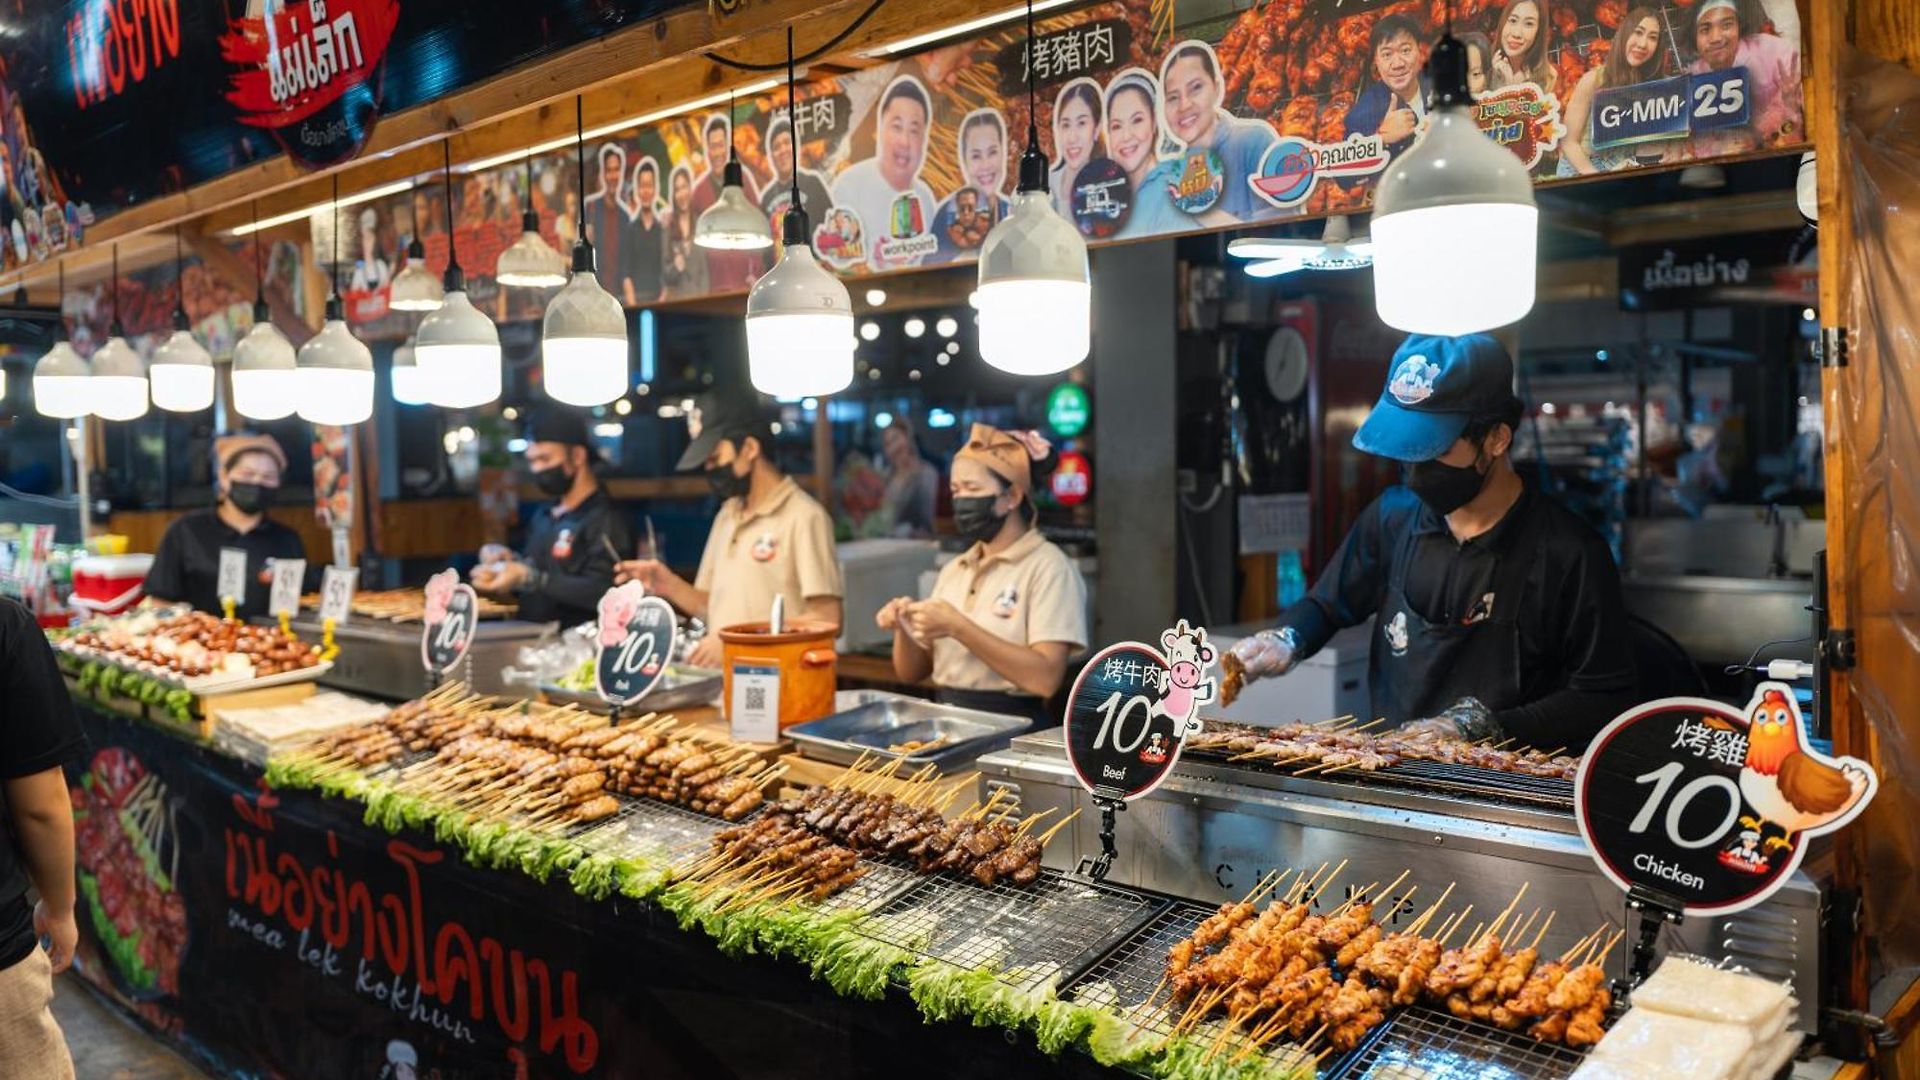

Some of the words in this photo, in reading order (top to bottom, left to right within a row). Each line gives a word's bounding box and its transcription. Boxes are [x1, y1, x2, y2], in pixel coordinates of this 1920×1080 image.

[1021, 24, 1114, 82] 烤豬肉
[1694, 78, 1743, 117] 25
[883, 239, 935, 257] workpoint
[434, 611, 465, 649] 10
[611, 630, 655, 674] 10
[1103, 657, 1162, 689] 烤牛肉
[1092, 691, 1152, 753] 10
[1671, 718, 1749, 767] 烤雞
[1102, 765, 1127, 780] Beef
[1628, 761, 1741, 849] 10
[1633, 853, 1705, 890] Chicken
[298, 926, 343, 977] lek
[354, 958, 477, 1045] kokhun
